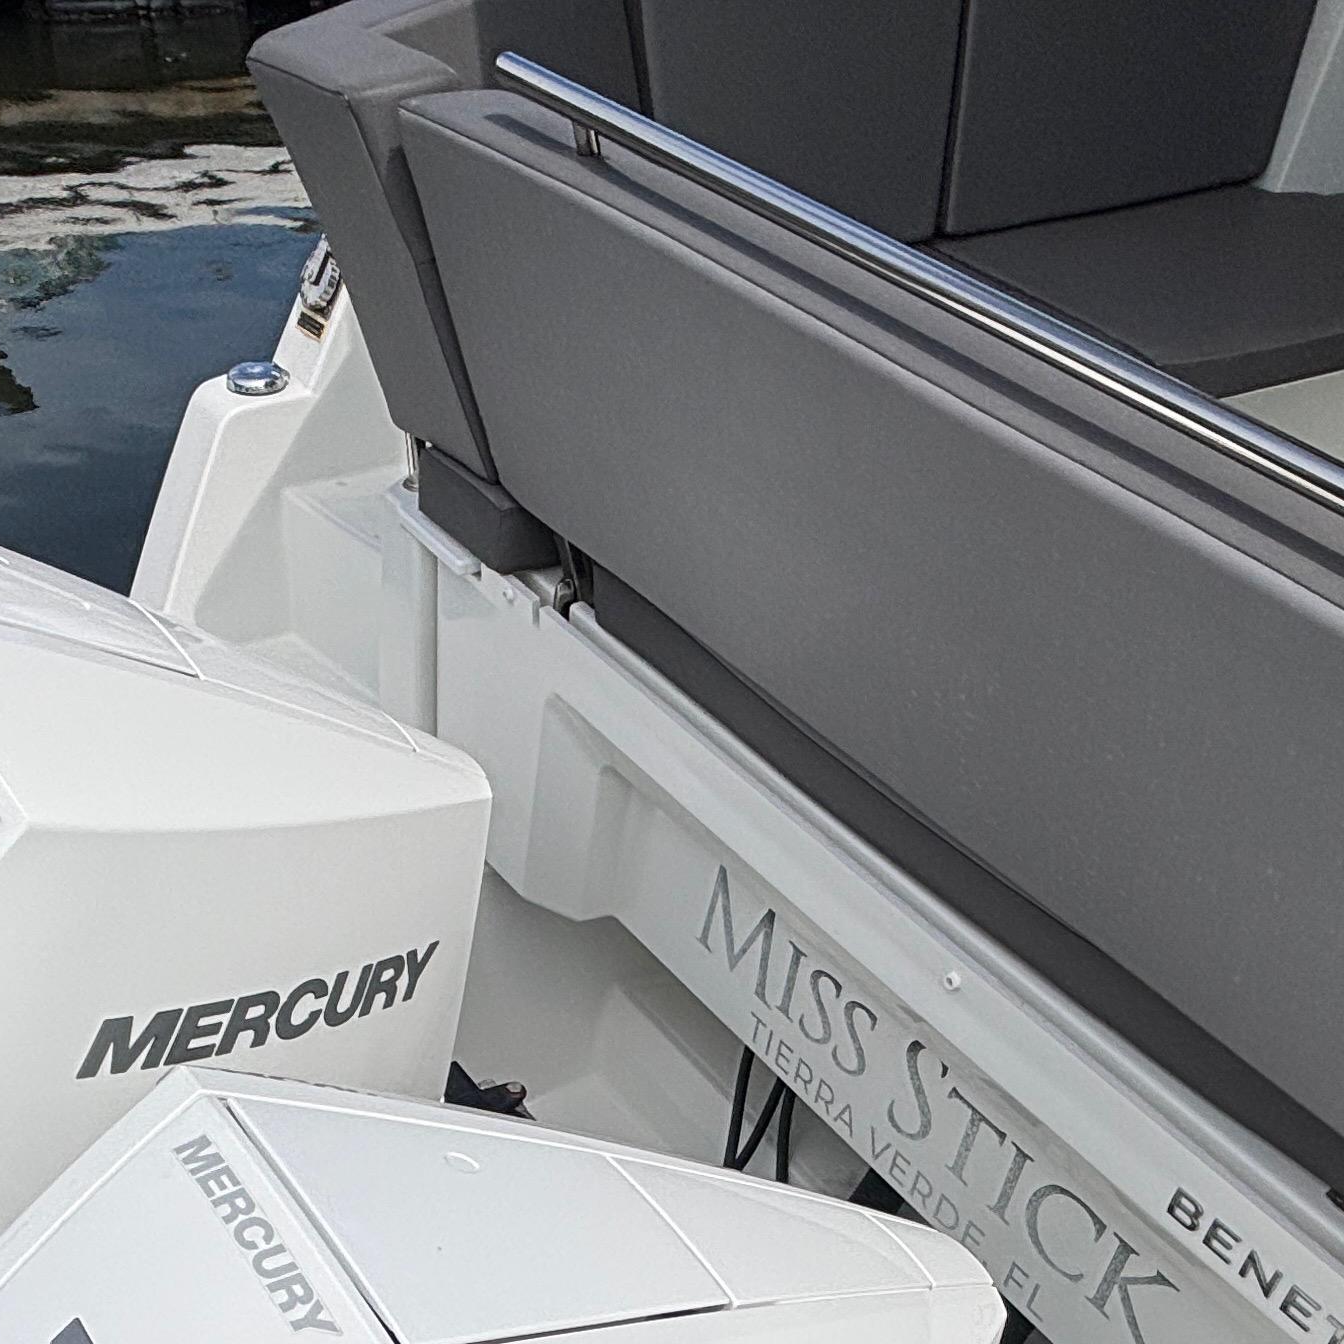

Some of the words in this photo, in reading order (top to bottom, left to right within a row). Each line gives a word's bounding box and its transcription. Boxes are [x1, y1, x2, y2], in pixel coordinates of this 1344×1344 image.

[75, 939, 440, 1080] MERCURY
[697, 864, 879, 1078] MISS
[172, 1134, 344, 1338] MERCURY
[750, 1010, 856, 1138] TIERRA
[1002, 1260, 1045, 1324] FL
